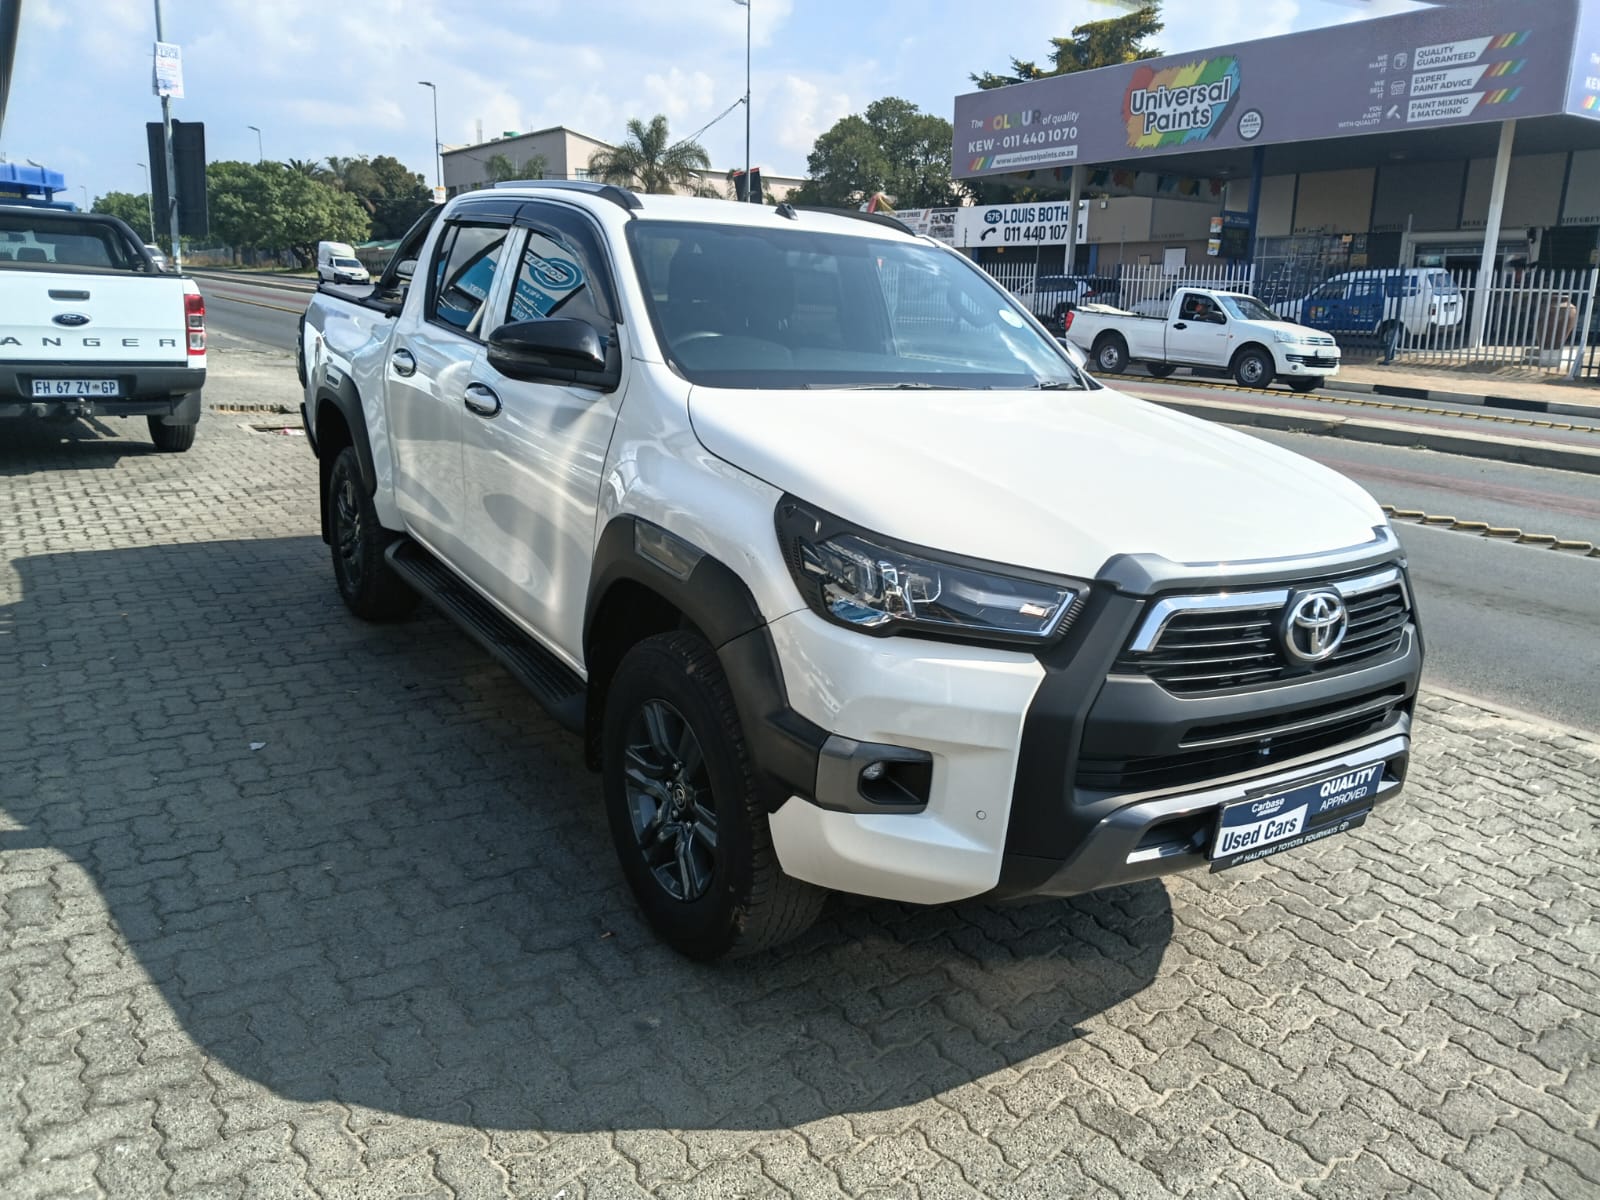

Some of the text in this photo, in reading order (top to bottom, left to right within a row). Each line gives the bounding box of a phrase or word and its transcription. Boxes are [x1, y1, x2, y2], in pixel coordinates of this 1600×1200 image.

[1416, 51, 1476, 66] GUARANTEED
[1418, 46, 1454, 58] QUALITY
[1413, 79, 1473, 92] PAINT ADVICE
[1414, 73, 1448, 84] EXPERT
[1131, 77, 1230, 113] Universal
[1411, 97, 1469, 110] PAINT MIXING
[1052, 111, 1080, 125] quality
[1145, 106, 1210, 133] Paints
[1417, 107, 1462, 118] MATCHING
[1354, 118, 1381, 127] QUALITY
[968, 138, 995, 153] KEW
[1003, 135, 1020, 148] 011
[1022, 131, 1046, 145] 440
[1048, 127, 1078, 142] 1070
[987, 213, 1000, 221] 575
[1003, 207, 1035, 224] LOUIS
[1004, 226, 1021, 242] 011
[1023, 225, 1046, 241] 440
[35, 381, 115, 394] FH 67 ZY GP
[1320, 767, 1377, 797] QUALITY
[1320, 786, 1368, 811] APPROVED
[1222, 817, 1298, 852] Used Cars
[1244, 846, 1277, 862] HALFWAY
